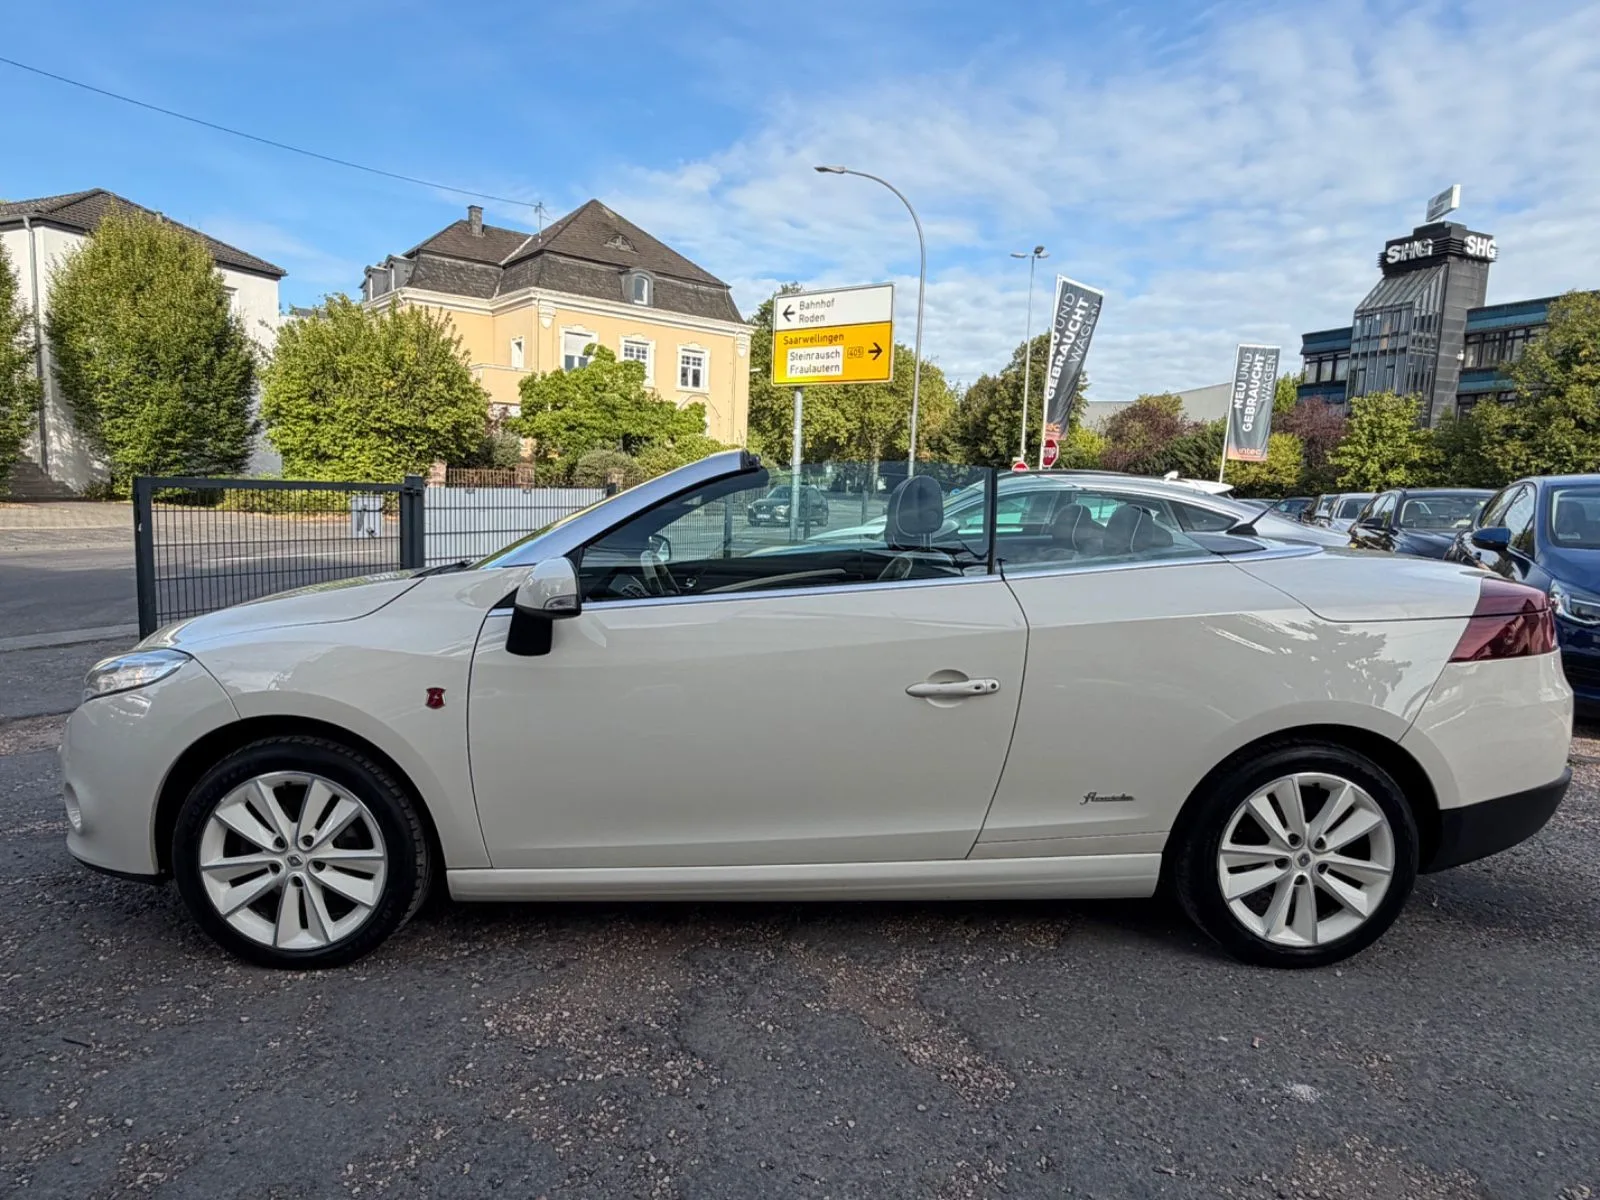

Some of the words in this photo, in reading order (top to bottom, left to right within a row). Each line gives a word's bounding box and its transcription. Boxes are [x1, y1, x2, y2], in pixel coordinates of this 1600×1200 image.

[1465, 235, 1497, 259] SHG
[799, 298, 835, 311] Bahnhof
[1055, 292, 1075, 329] UND
[799, 313, 825, 323] Roden
[783, 333, 845, 346] Saarwellingen
[1047, 296, 1090, 400] GEBRAUCHT
[789, 349, 841, 362] Steinrausch
[789, 363, 841, 375] Fraulautern
[1233, 382, 1247, 409] NEU
[1240, 353, 1253, 381] UND
[1260, 354, 1276, 402] WAGEN
[1242, 353, 1265, 432] GEBRAUCHT
